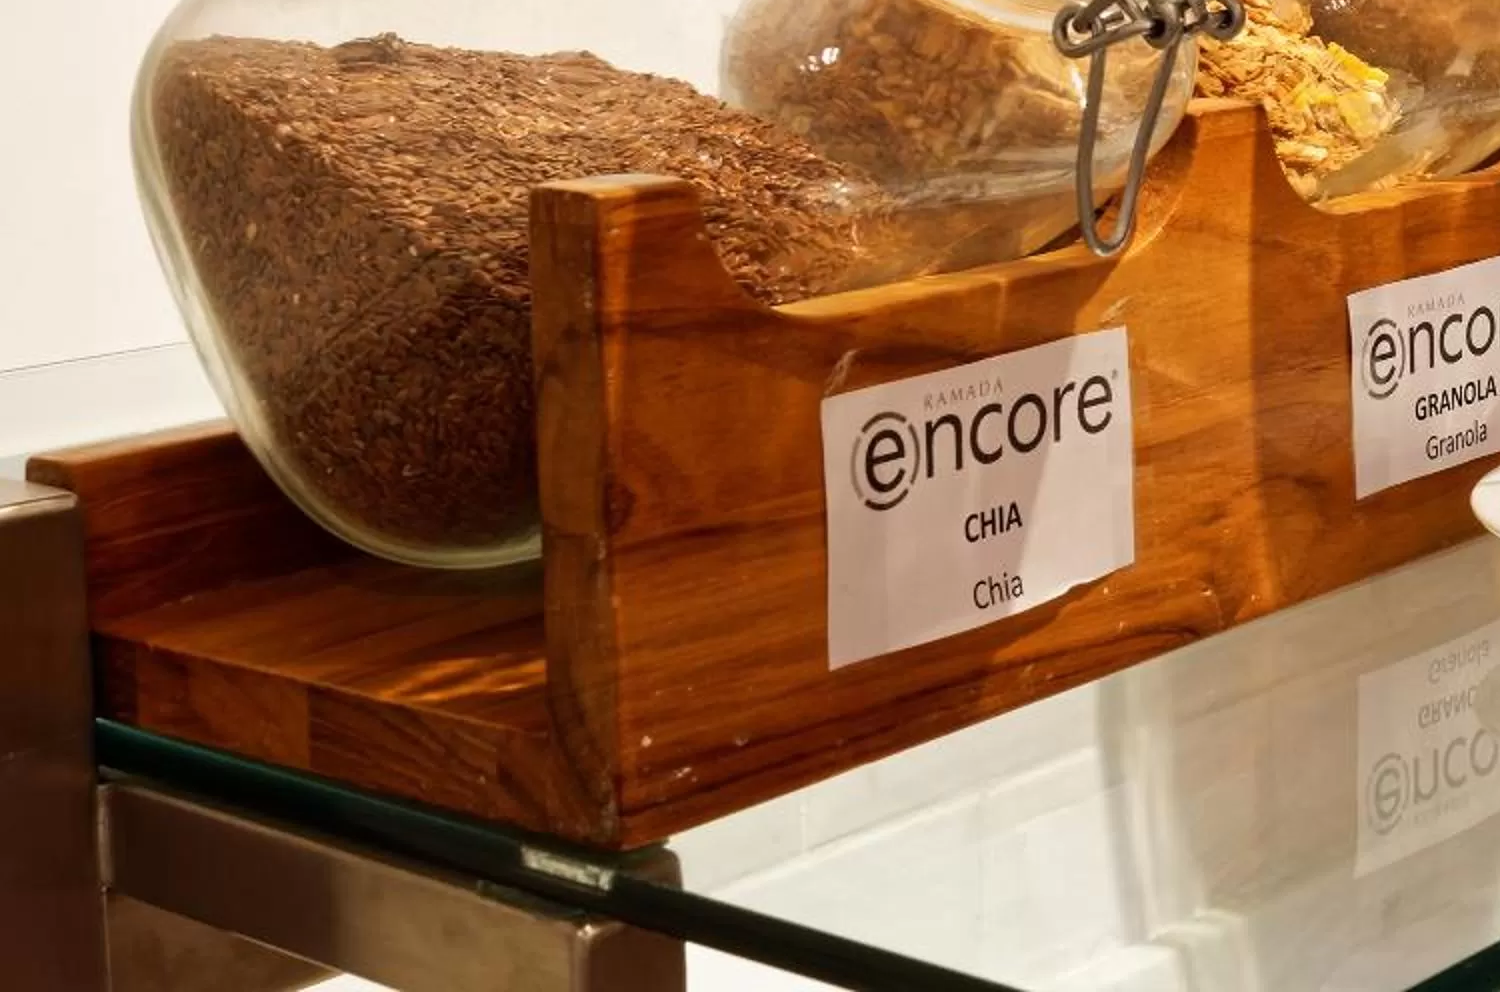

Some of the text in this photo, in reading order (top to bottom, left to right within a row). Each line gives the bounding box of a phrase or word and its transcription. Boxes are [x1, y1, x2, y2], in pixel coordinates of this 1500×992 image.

[1407, 292, 1466, 317] RAMADA
[923, 376, 1004, 409] RAMADA
[1415, 376, 1498, 421] GRANOLA
[852, 374, 1113, 510] encore
[1425, 419, 1488, 460] Granola
[964, 501, 1023, 543] CHIA
[972, 572, 1024, 610] Chia
